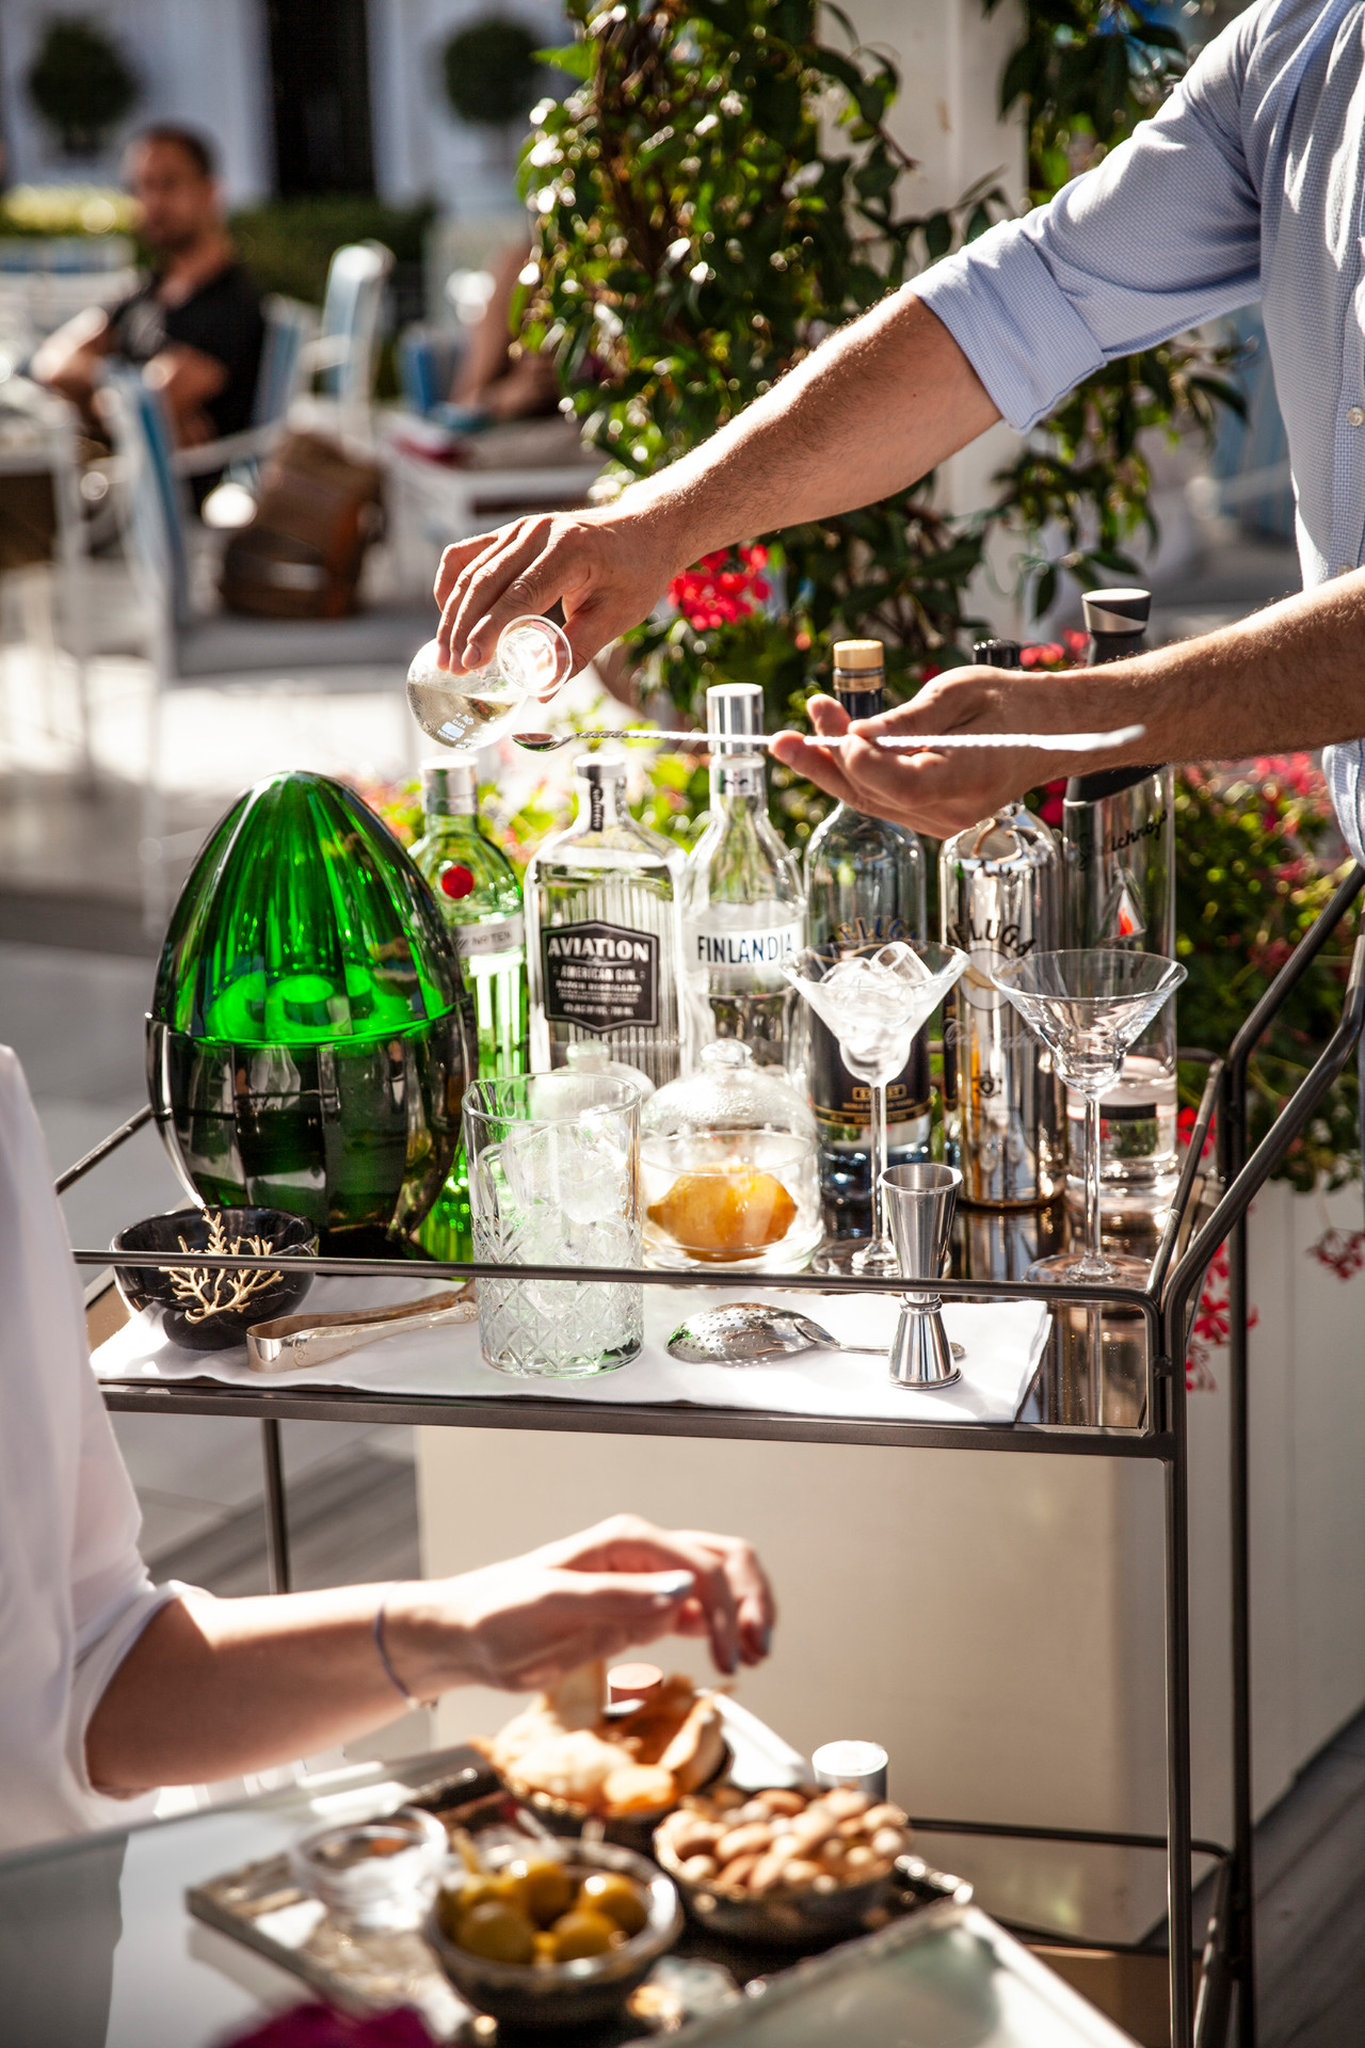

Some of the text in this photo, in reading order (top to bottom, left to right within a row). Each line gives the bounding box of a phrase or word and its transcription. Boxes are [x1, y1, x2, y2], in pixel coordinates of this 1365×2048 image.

[547, 936, 650, 963] AVIATION
[697, 932, 794, 964] FINLANDIA
[944, 918, 1036, 957] ELUGA
[560, 965, 615, 981] AMERICAN
